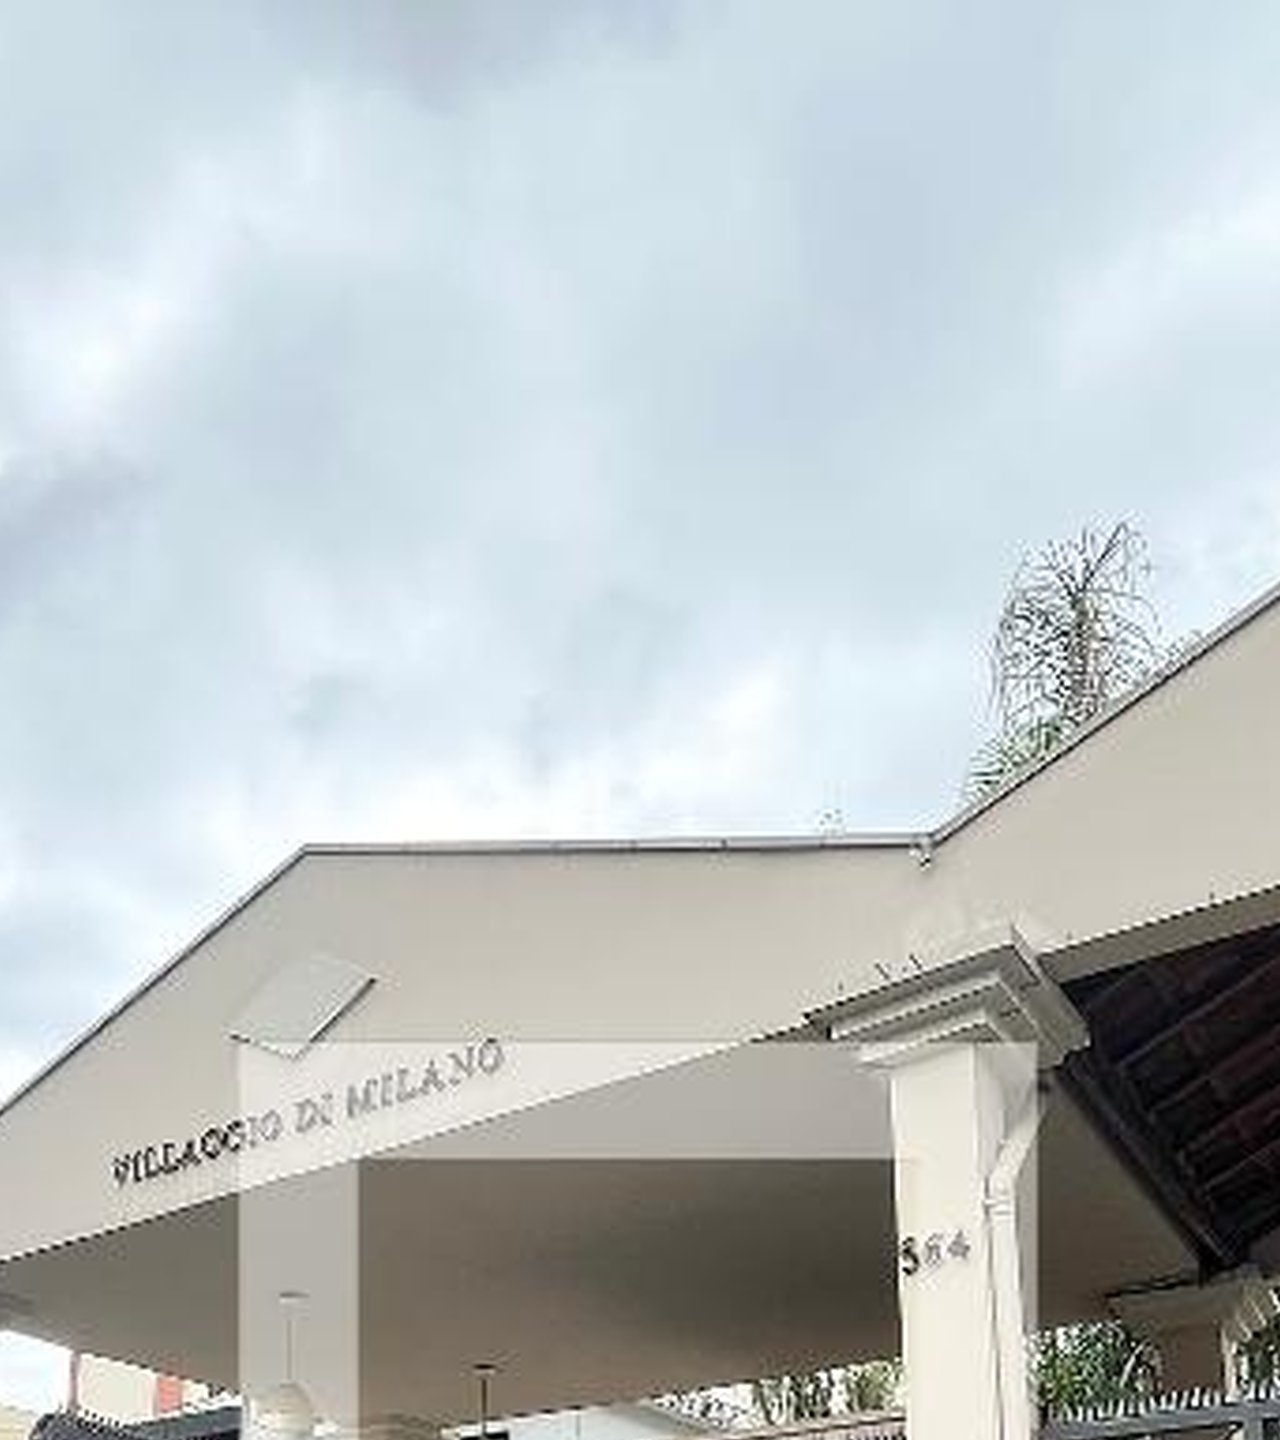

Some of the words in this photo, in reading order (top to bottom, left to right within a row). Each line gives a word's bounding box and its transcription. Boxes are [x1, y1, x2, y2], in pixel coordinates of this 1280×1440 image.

[113, 1109, 283, 1188] VILLAGGIO
[293, 1093, 334, 1133] DI
[346, 1036, 507, 1118] MILANO
